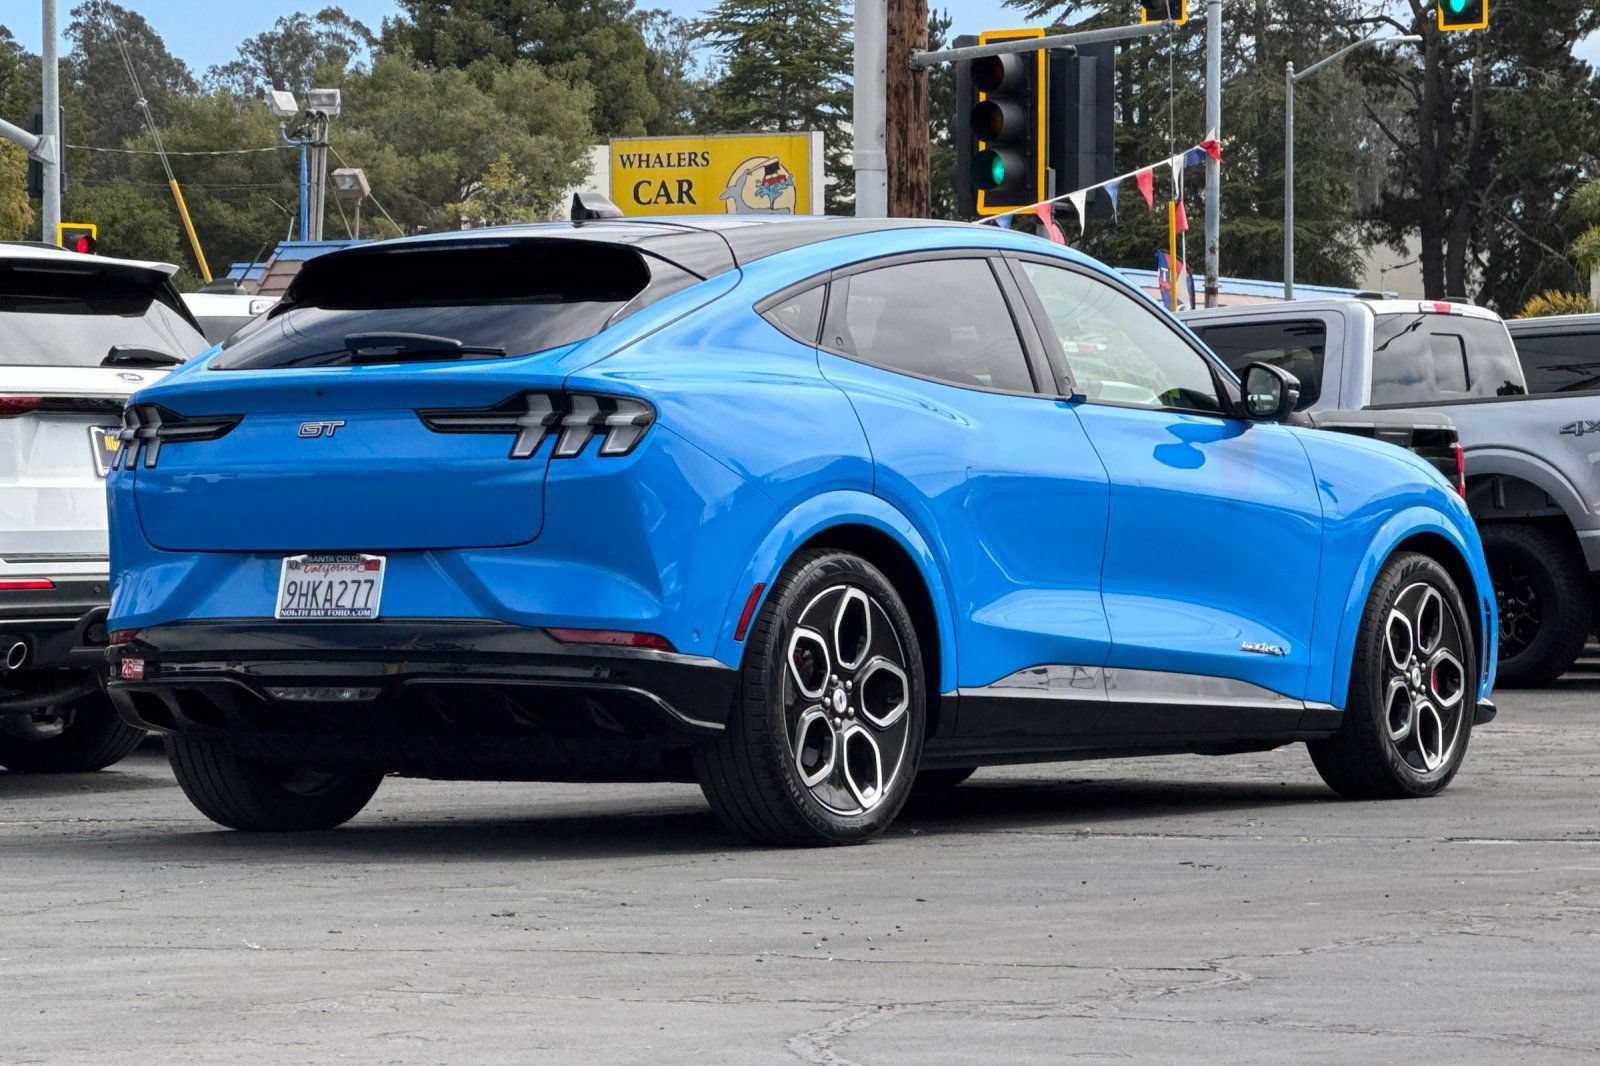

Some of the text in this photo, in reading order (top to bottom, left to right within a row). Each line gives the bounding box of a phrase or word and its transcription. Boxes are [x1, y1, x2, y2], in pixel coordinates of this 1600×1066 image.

[619, 151, 710, 169] WHALERS
[633, 179, 697, 206] CAR
[298, 420, 345, 437] GT
[307, 555, 359, 563] SANTA CRUZ
[304, 564, 359, 578] California
[285, 579, 375, 608] 9HKA277
[310, 609, 326, 617] BAY
